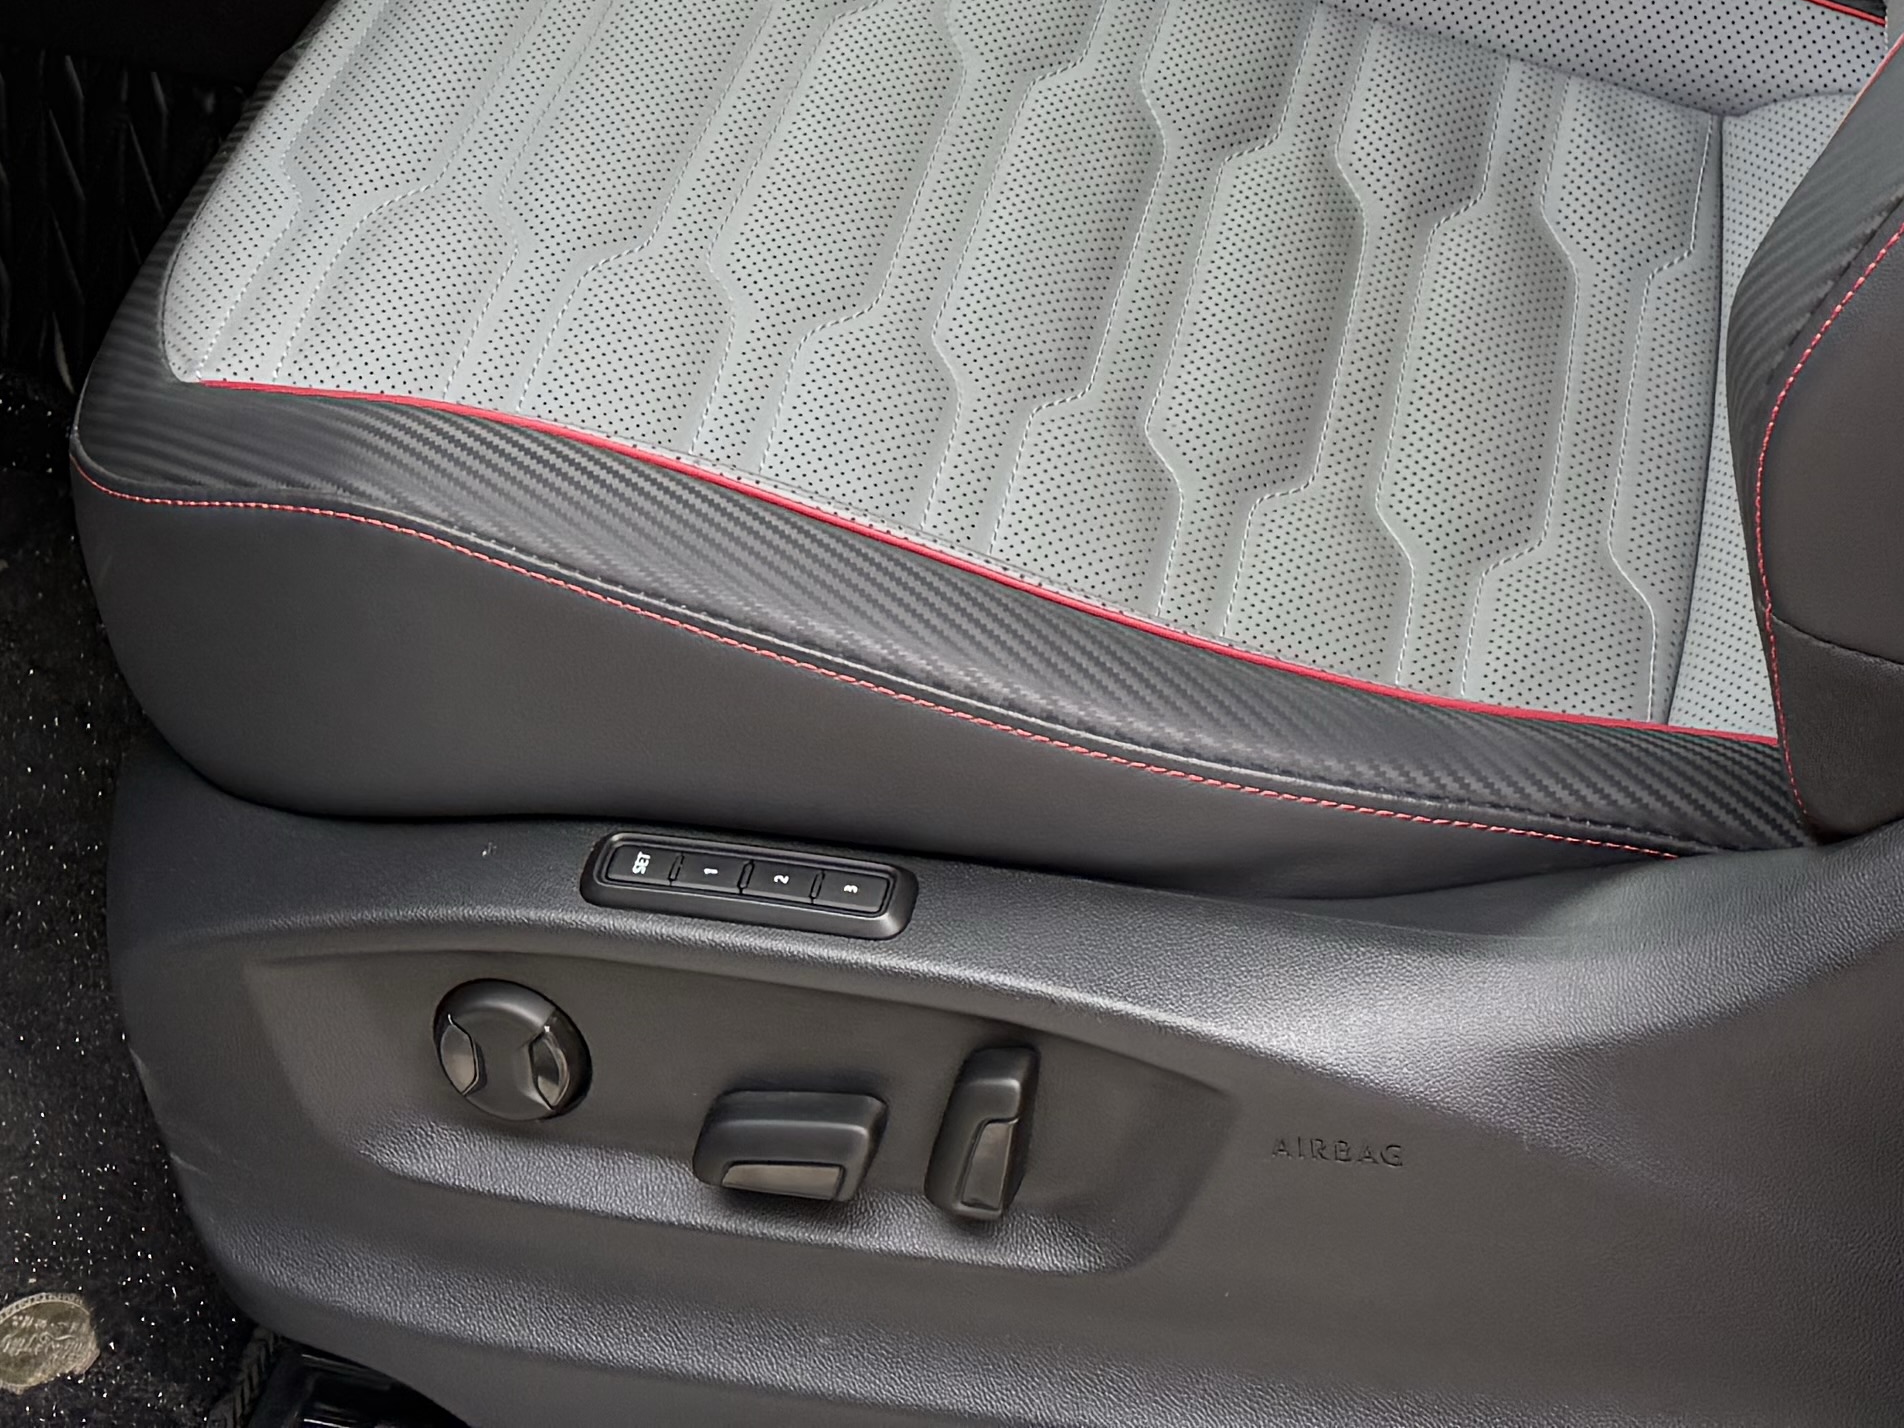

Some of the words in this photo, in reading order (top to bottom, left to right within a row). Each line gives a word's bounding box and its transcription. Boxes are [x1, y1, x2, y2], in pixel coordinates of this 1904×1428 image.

[632, 851, 651, 874] SET
[774, 875, 789, 884] 2
[844, 885, 858, 894] 3
[1272, 1136, 1403, 1167] AIRBAG
